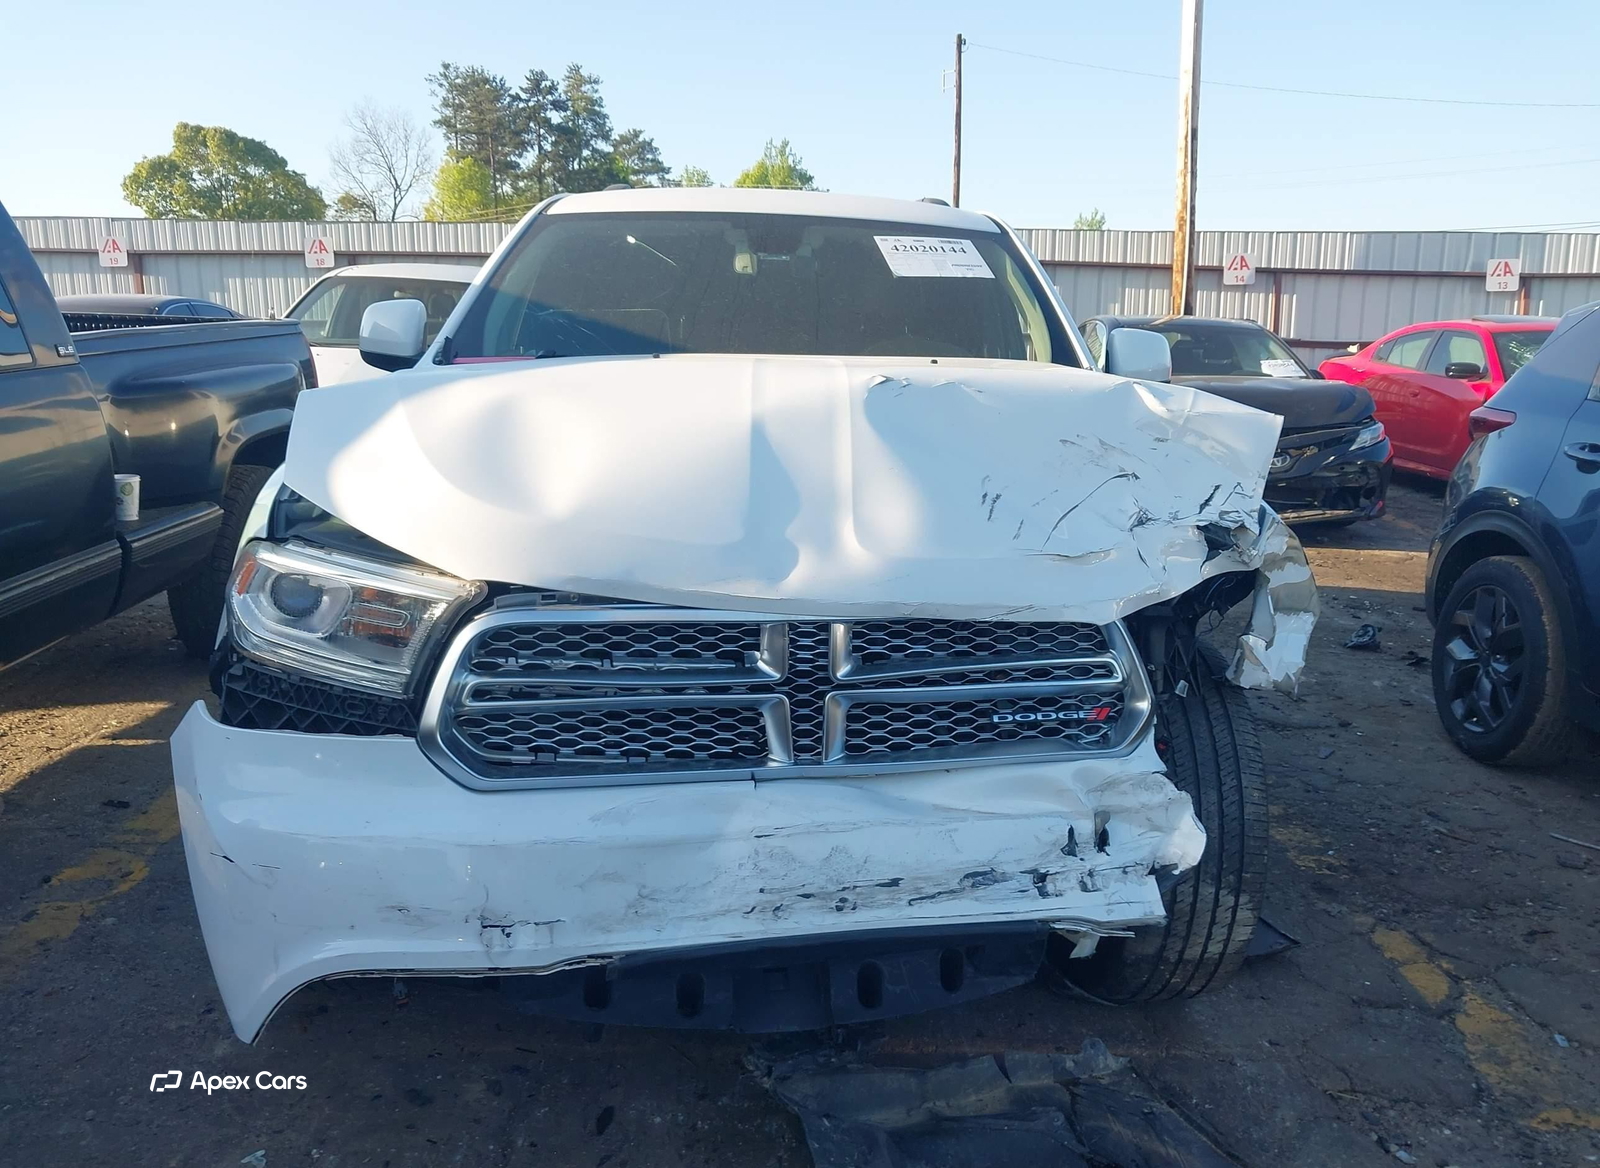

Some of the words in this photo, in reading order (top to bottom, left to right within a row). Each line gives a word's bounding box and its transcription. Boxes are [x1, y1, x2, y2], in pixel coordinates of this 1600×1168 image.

[890, 244, 967, 255] 42020144
[109, 257, 119, 265] 19
[315, 258, 326, 266] 18
[1234, 275, 1245, 283] 14
[1497, 281, 1508, 290] 13
[992, 710, 1098, 723] DODGE
